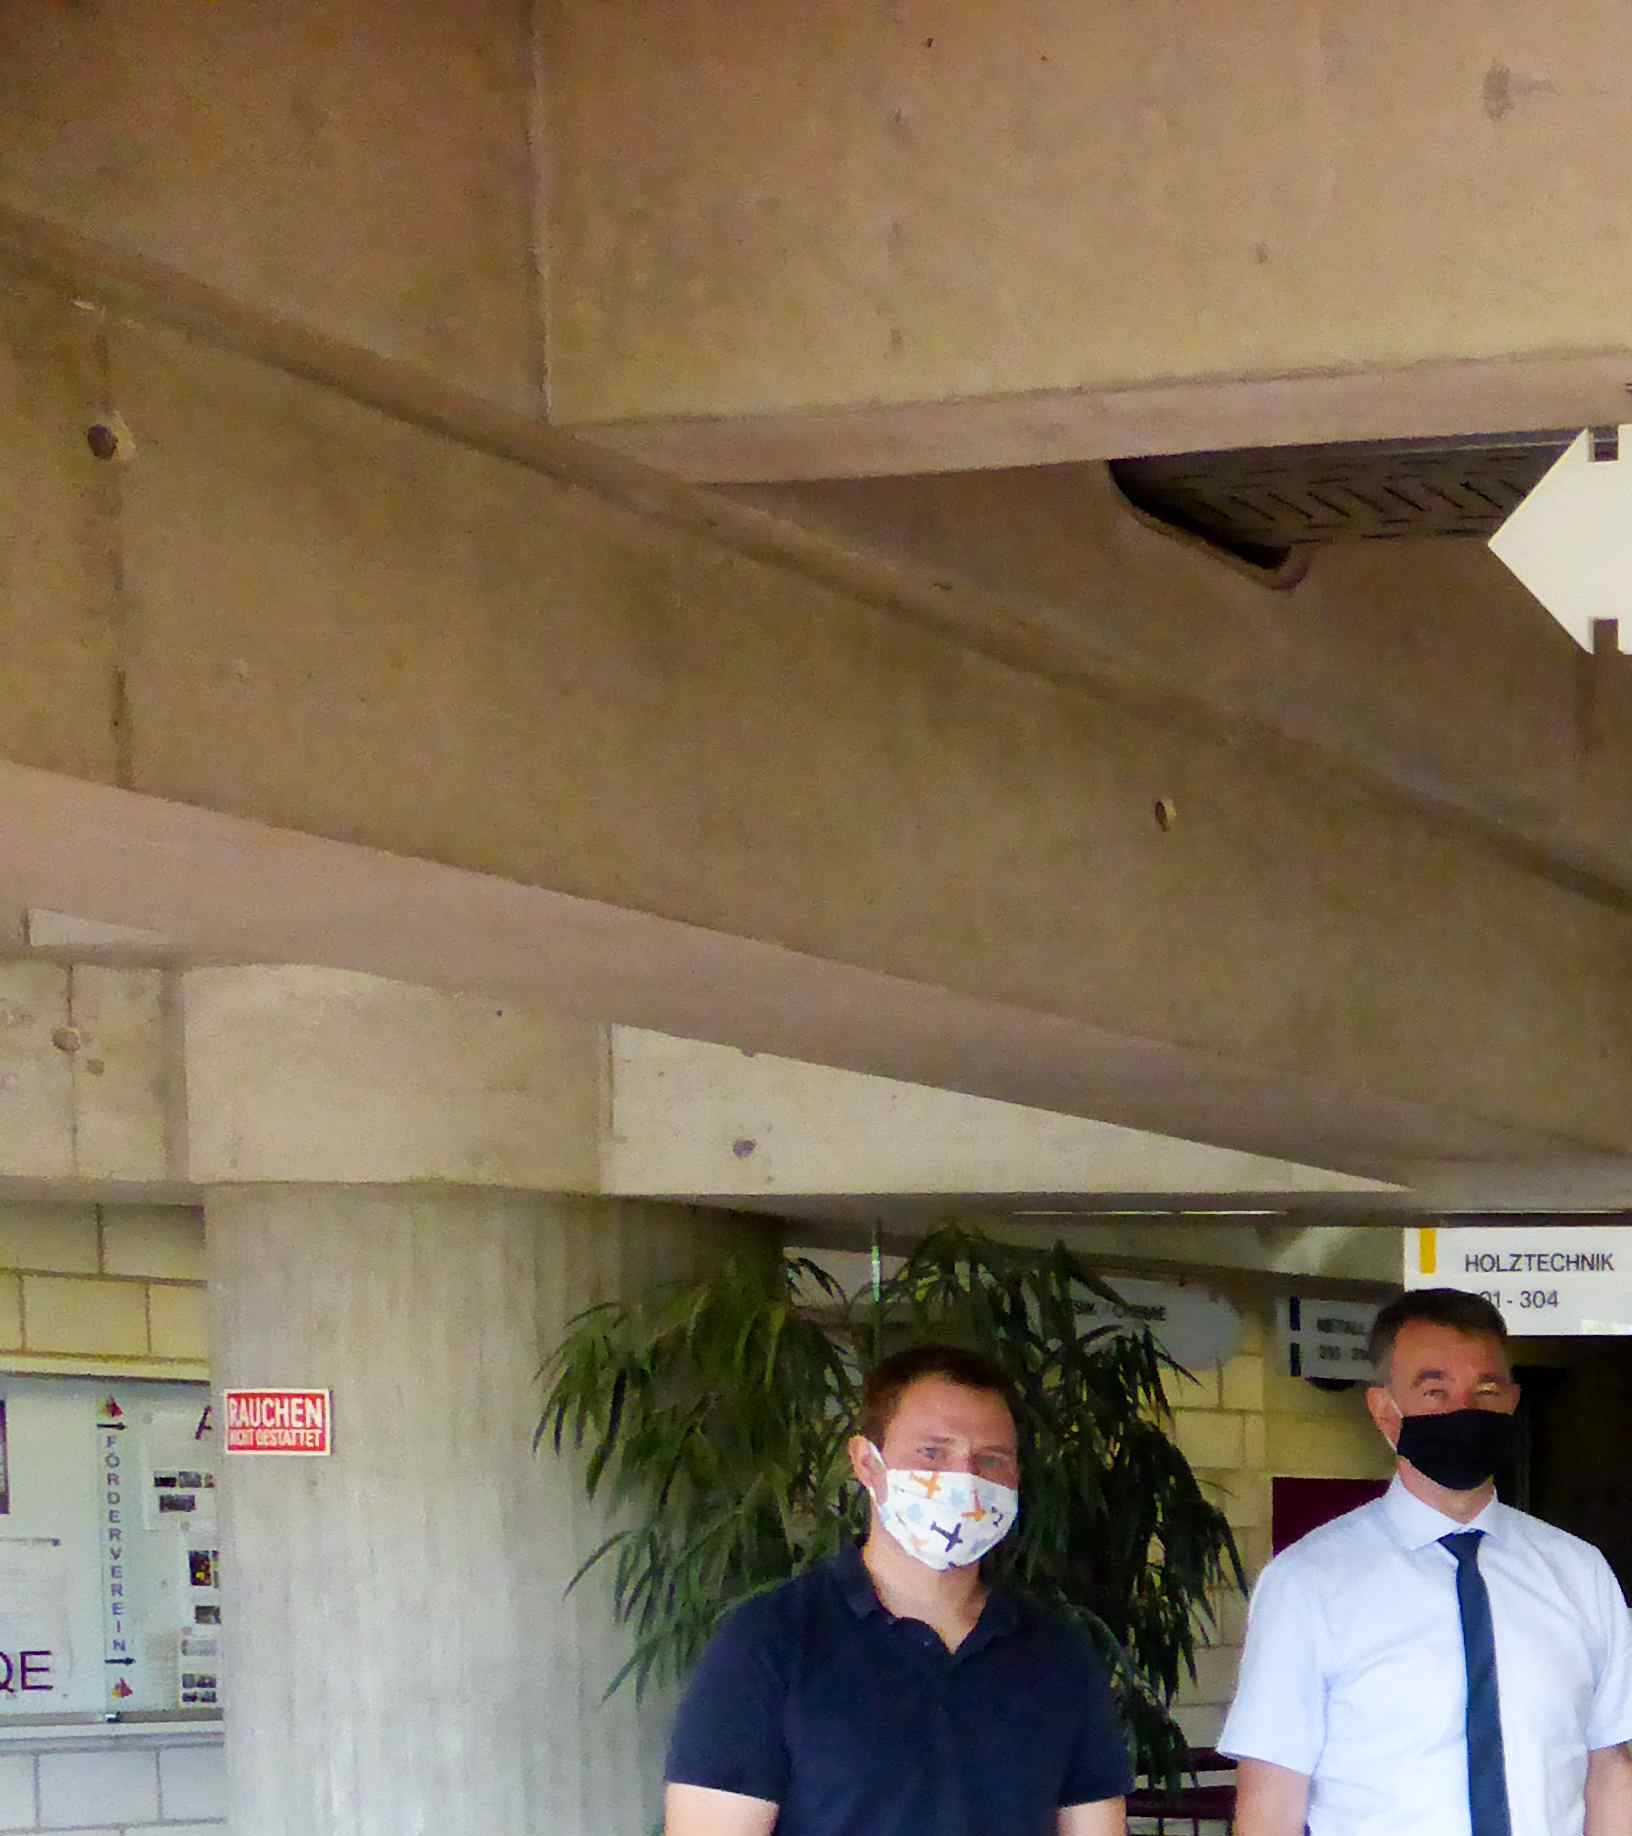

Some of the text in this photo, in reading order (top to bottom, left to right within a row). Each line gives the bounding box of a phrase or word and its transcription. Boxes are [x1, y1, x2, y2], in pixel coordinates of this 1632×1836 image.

[1464, 1253, 1615, 1273] HOLZTECHNIK
[1520, 1290, 1559, 1309] 304
[228, 1397, 323, 1428] RAUCHEN
